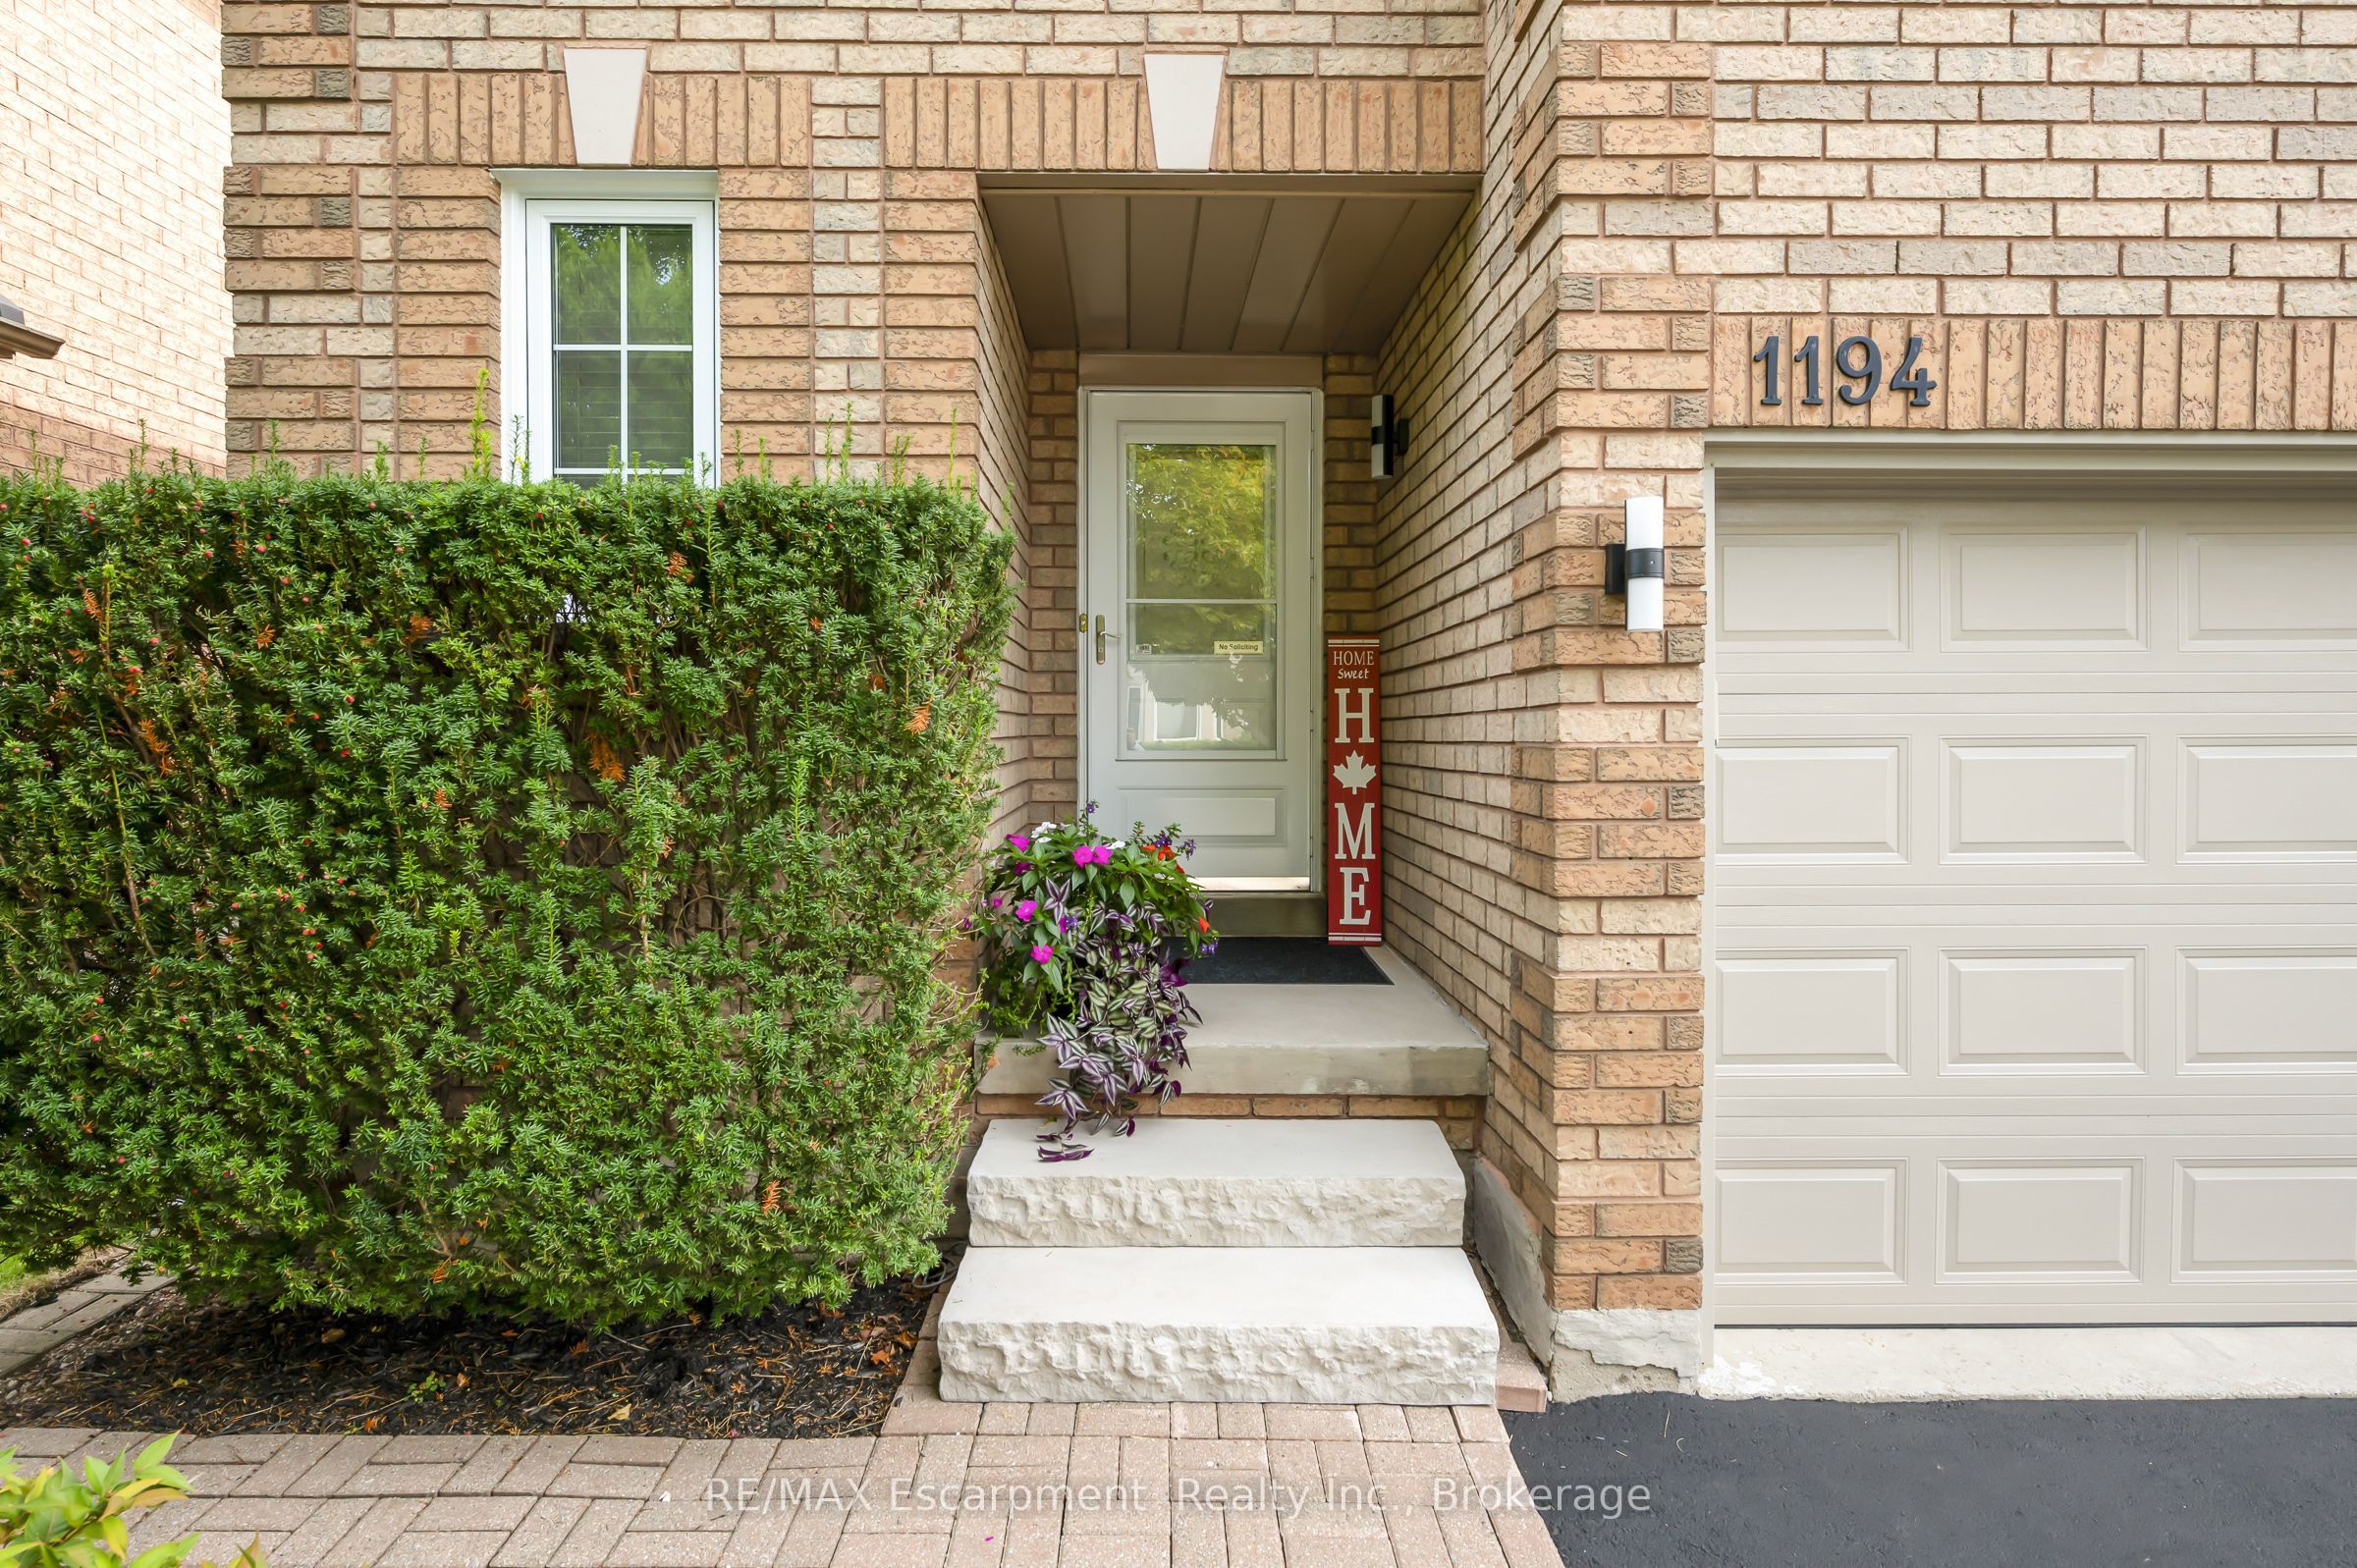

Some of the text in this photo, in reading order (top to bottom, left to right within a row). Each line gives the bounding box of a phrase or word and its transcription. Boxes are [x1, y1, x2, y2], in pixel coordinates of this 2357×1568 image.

[1753, 335, 1938, 407] 1194
[1229, 643, 1259, 652] Soliciting
[1333, 650, 1375, 666] HOME
[1337, 668, 1370, 679] Sweet
[1334, 687, 1376, 925] HME
